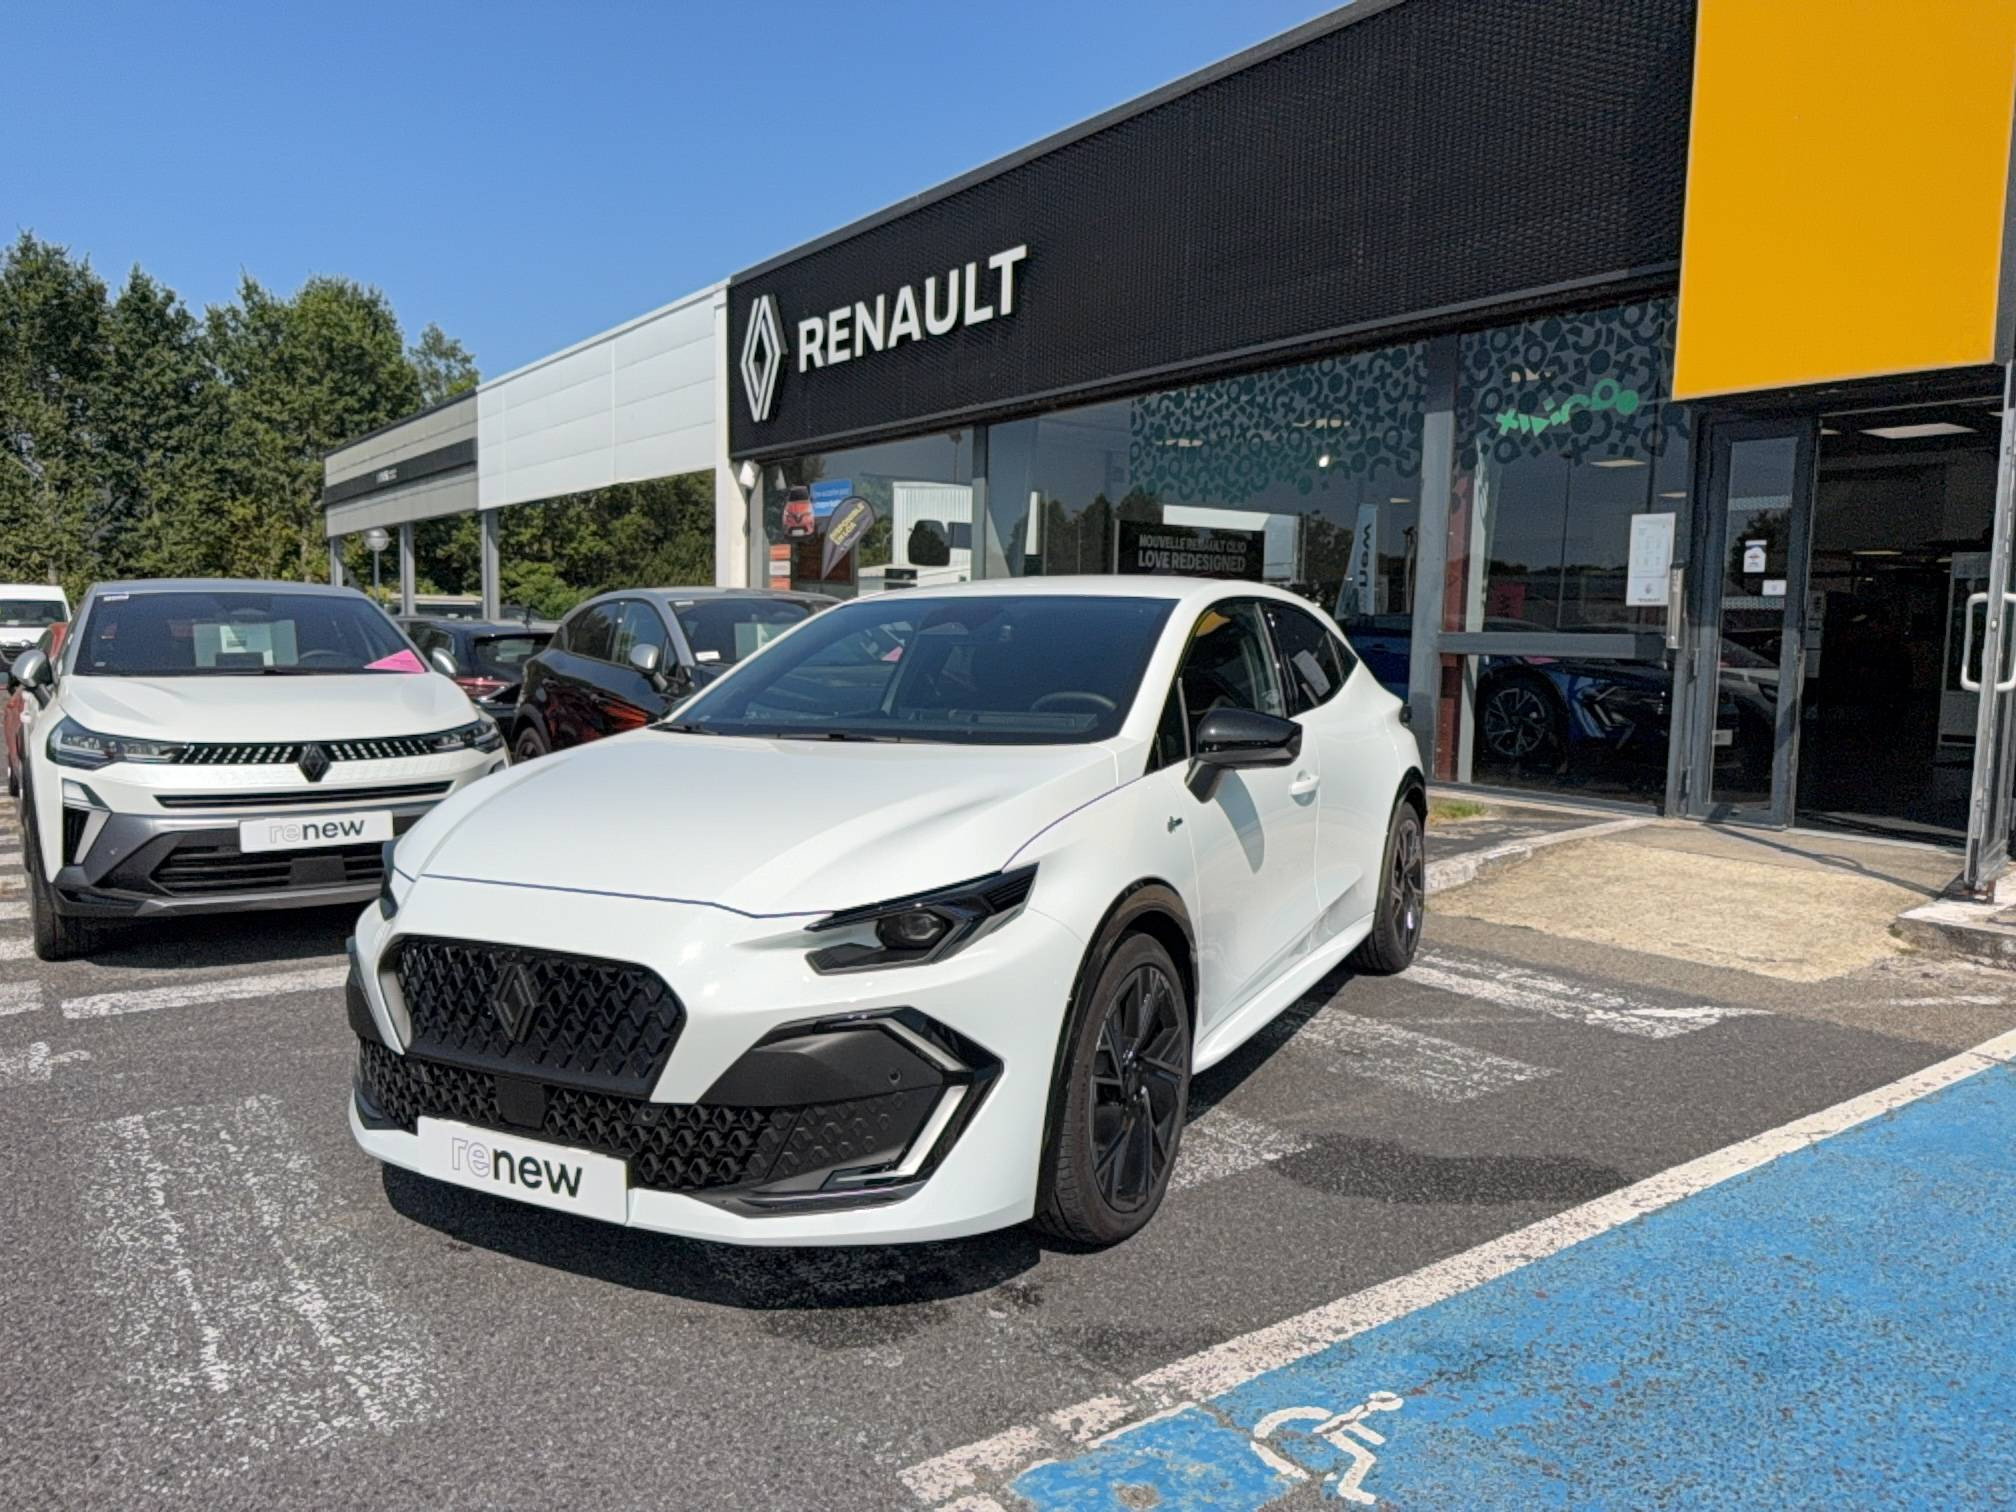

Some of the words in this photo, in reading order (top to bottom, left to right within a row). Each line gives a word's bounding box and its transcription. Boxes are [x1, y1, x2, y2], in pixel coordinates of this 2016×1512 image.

[798, 244, 1027, 373] RENAULT
[1138, 550, 1170, 569] LOVE
[1171, 552, 1246, 573] REDESIGNED
[270, 820, 365, 844] renew
[451, 1137, 582, 1198] renew
